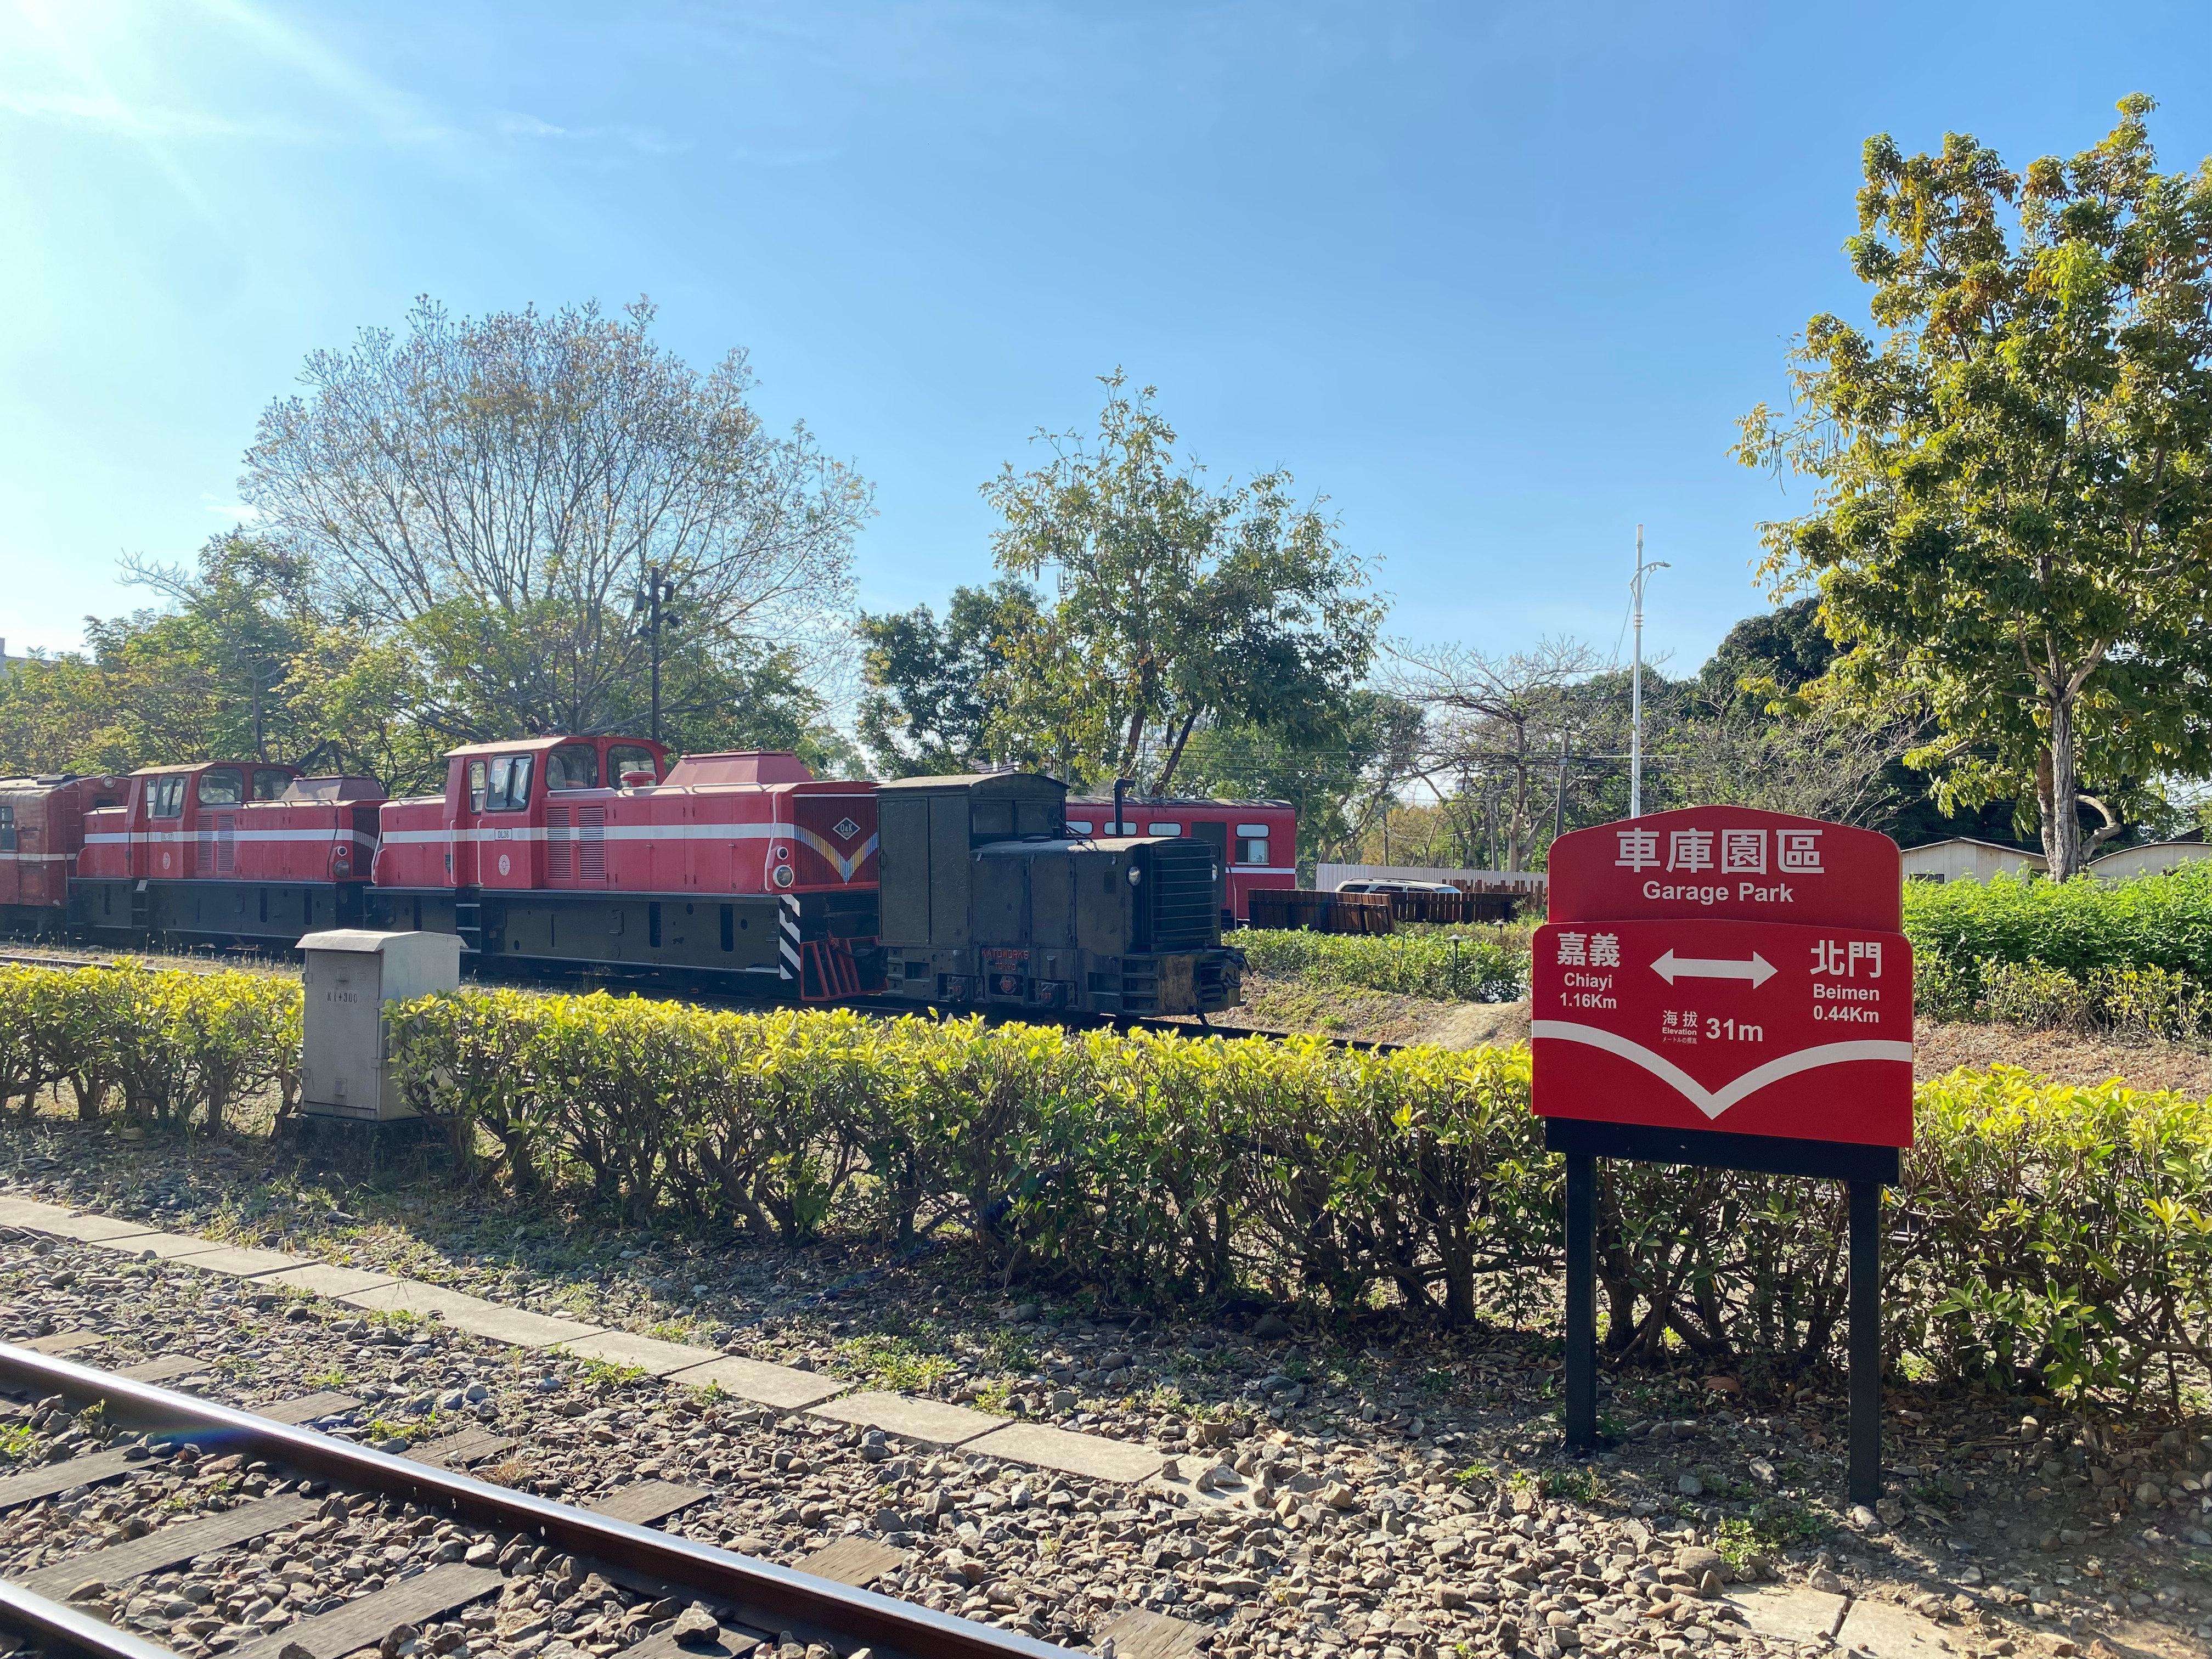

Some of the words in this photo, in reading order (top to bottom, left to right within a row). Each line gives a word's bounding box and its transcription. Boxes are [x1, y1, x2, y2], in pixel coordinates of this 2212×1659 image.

[840, 823, 853, 832] O&K
[1615, 827, 1825, 874] 車庫園區
[1643, 881, 1729, 905] Garage
[1739, 882, 1794, 902] Park
[1557, 932, 1620, 968] 嘉義
[1810, 940, 1882, 978] 北門
[996, 962, 1016, 970] TOKYO
[1564, 972, 1612, 991] Chiayi
[1560, 992, 1617, 1009] 1.16Km
[1813, 983, 1880, 1001] Beimen
[1813, 1005, 1879, 1023] 0.44Km
[1662, 1027, 1697, 1035] Elevation
[1706, 1018, 1763, 1042] 31m
